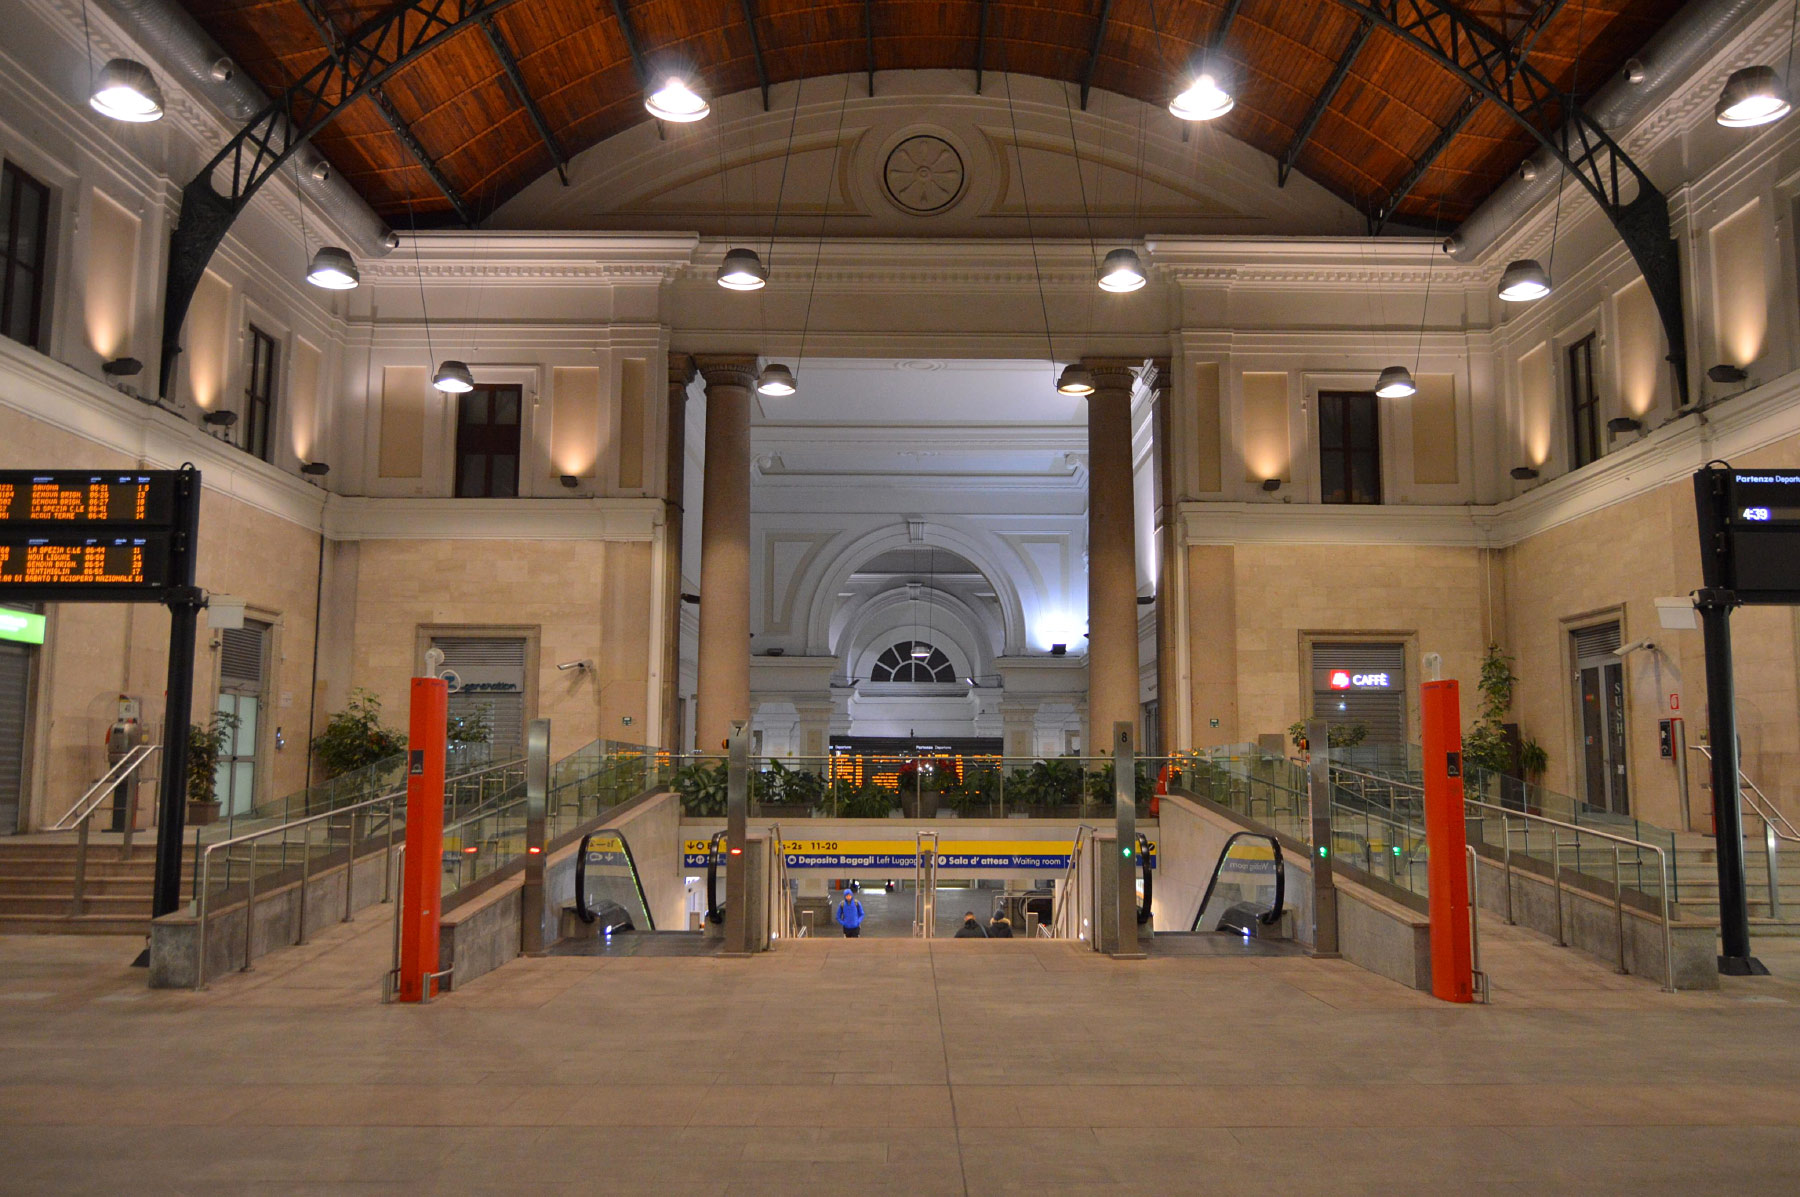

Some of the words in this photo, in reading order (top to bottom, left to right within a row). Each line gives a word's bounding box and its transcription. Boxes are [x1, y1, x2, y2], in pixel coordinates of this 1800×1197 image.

[1352, 672, 1390, 686] CAFFÈ
[1614, 682, 1623, 746] SUSHI
[735, 726, 741, 736] 7
[1122, 732, 1128, 742] 8
[782, 842, 802, 851] s-2s
[811, 842, 838, 851] 11-20
[798, 856, 838, 866] Deposito
[840, 856, 874, 867] Bagagli
[876, 856, 890, 865] Left
[949, 857, 968, 865] Sala
[1012, 857, 1039, 866] Waiting
